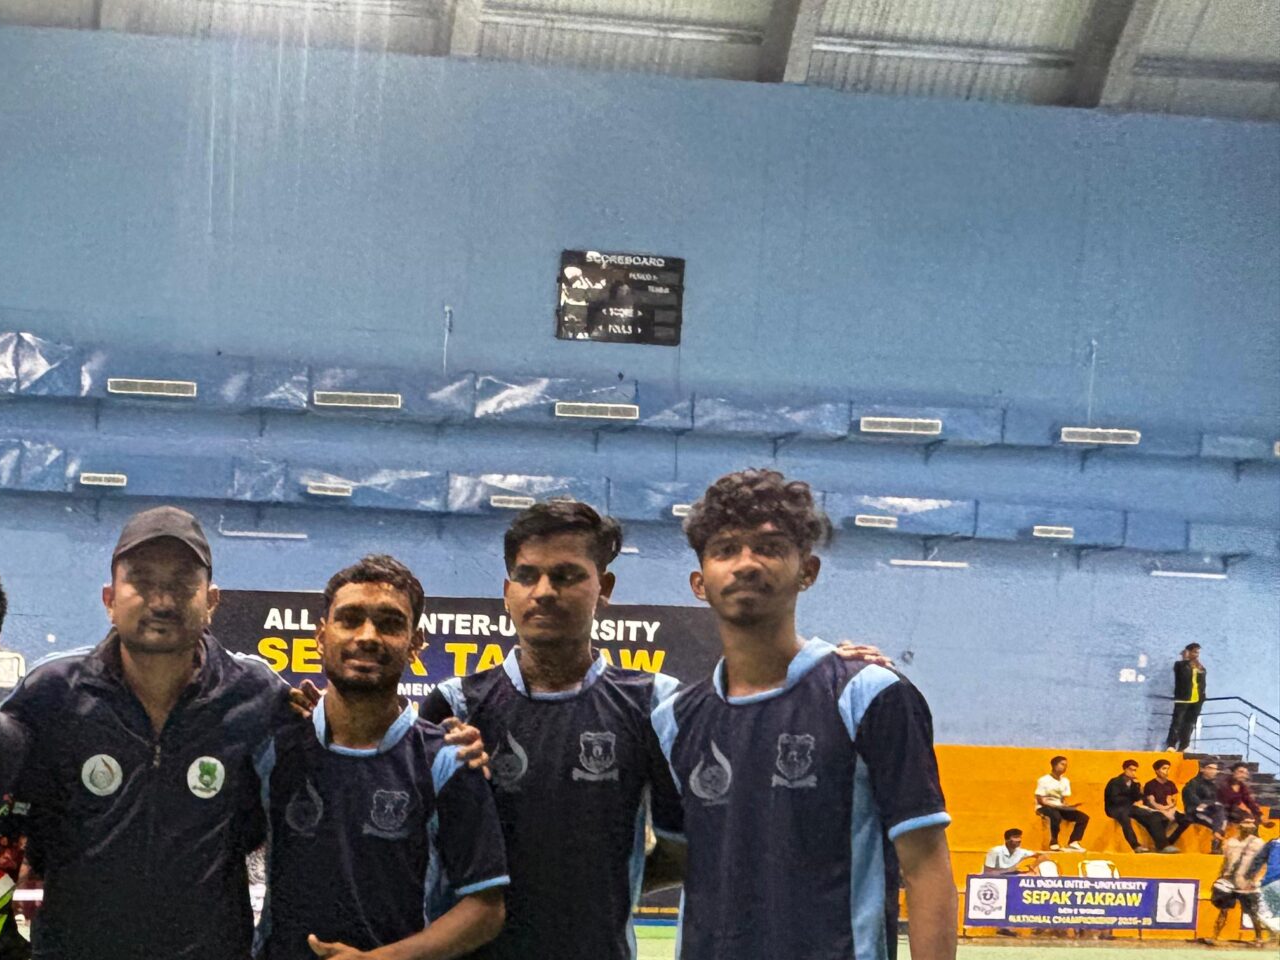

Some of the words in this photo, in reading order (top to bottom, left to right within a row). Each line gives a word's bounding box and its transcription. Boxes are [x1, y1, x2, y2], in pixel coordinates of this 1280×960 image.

[263, 607, 317, 631] ALL
[417, 613, 661, 642] NTER-URSITY
[1019, 879, 1035, 887] ALL
[1036, 879, 1063, 888] INDIA
[1022, 890, 1072, 905] SEPAK
[1074, 891, 1142, 907] TAKRAW
